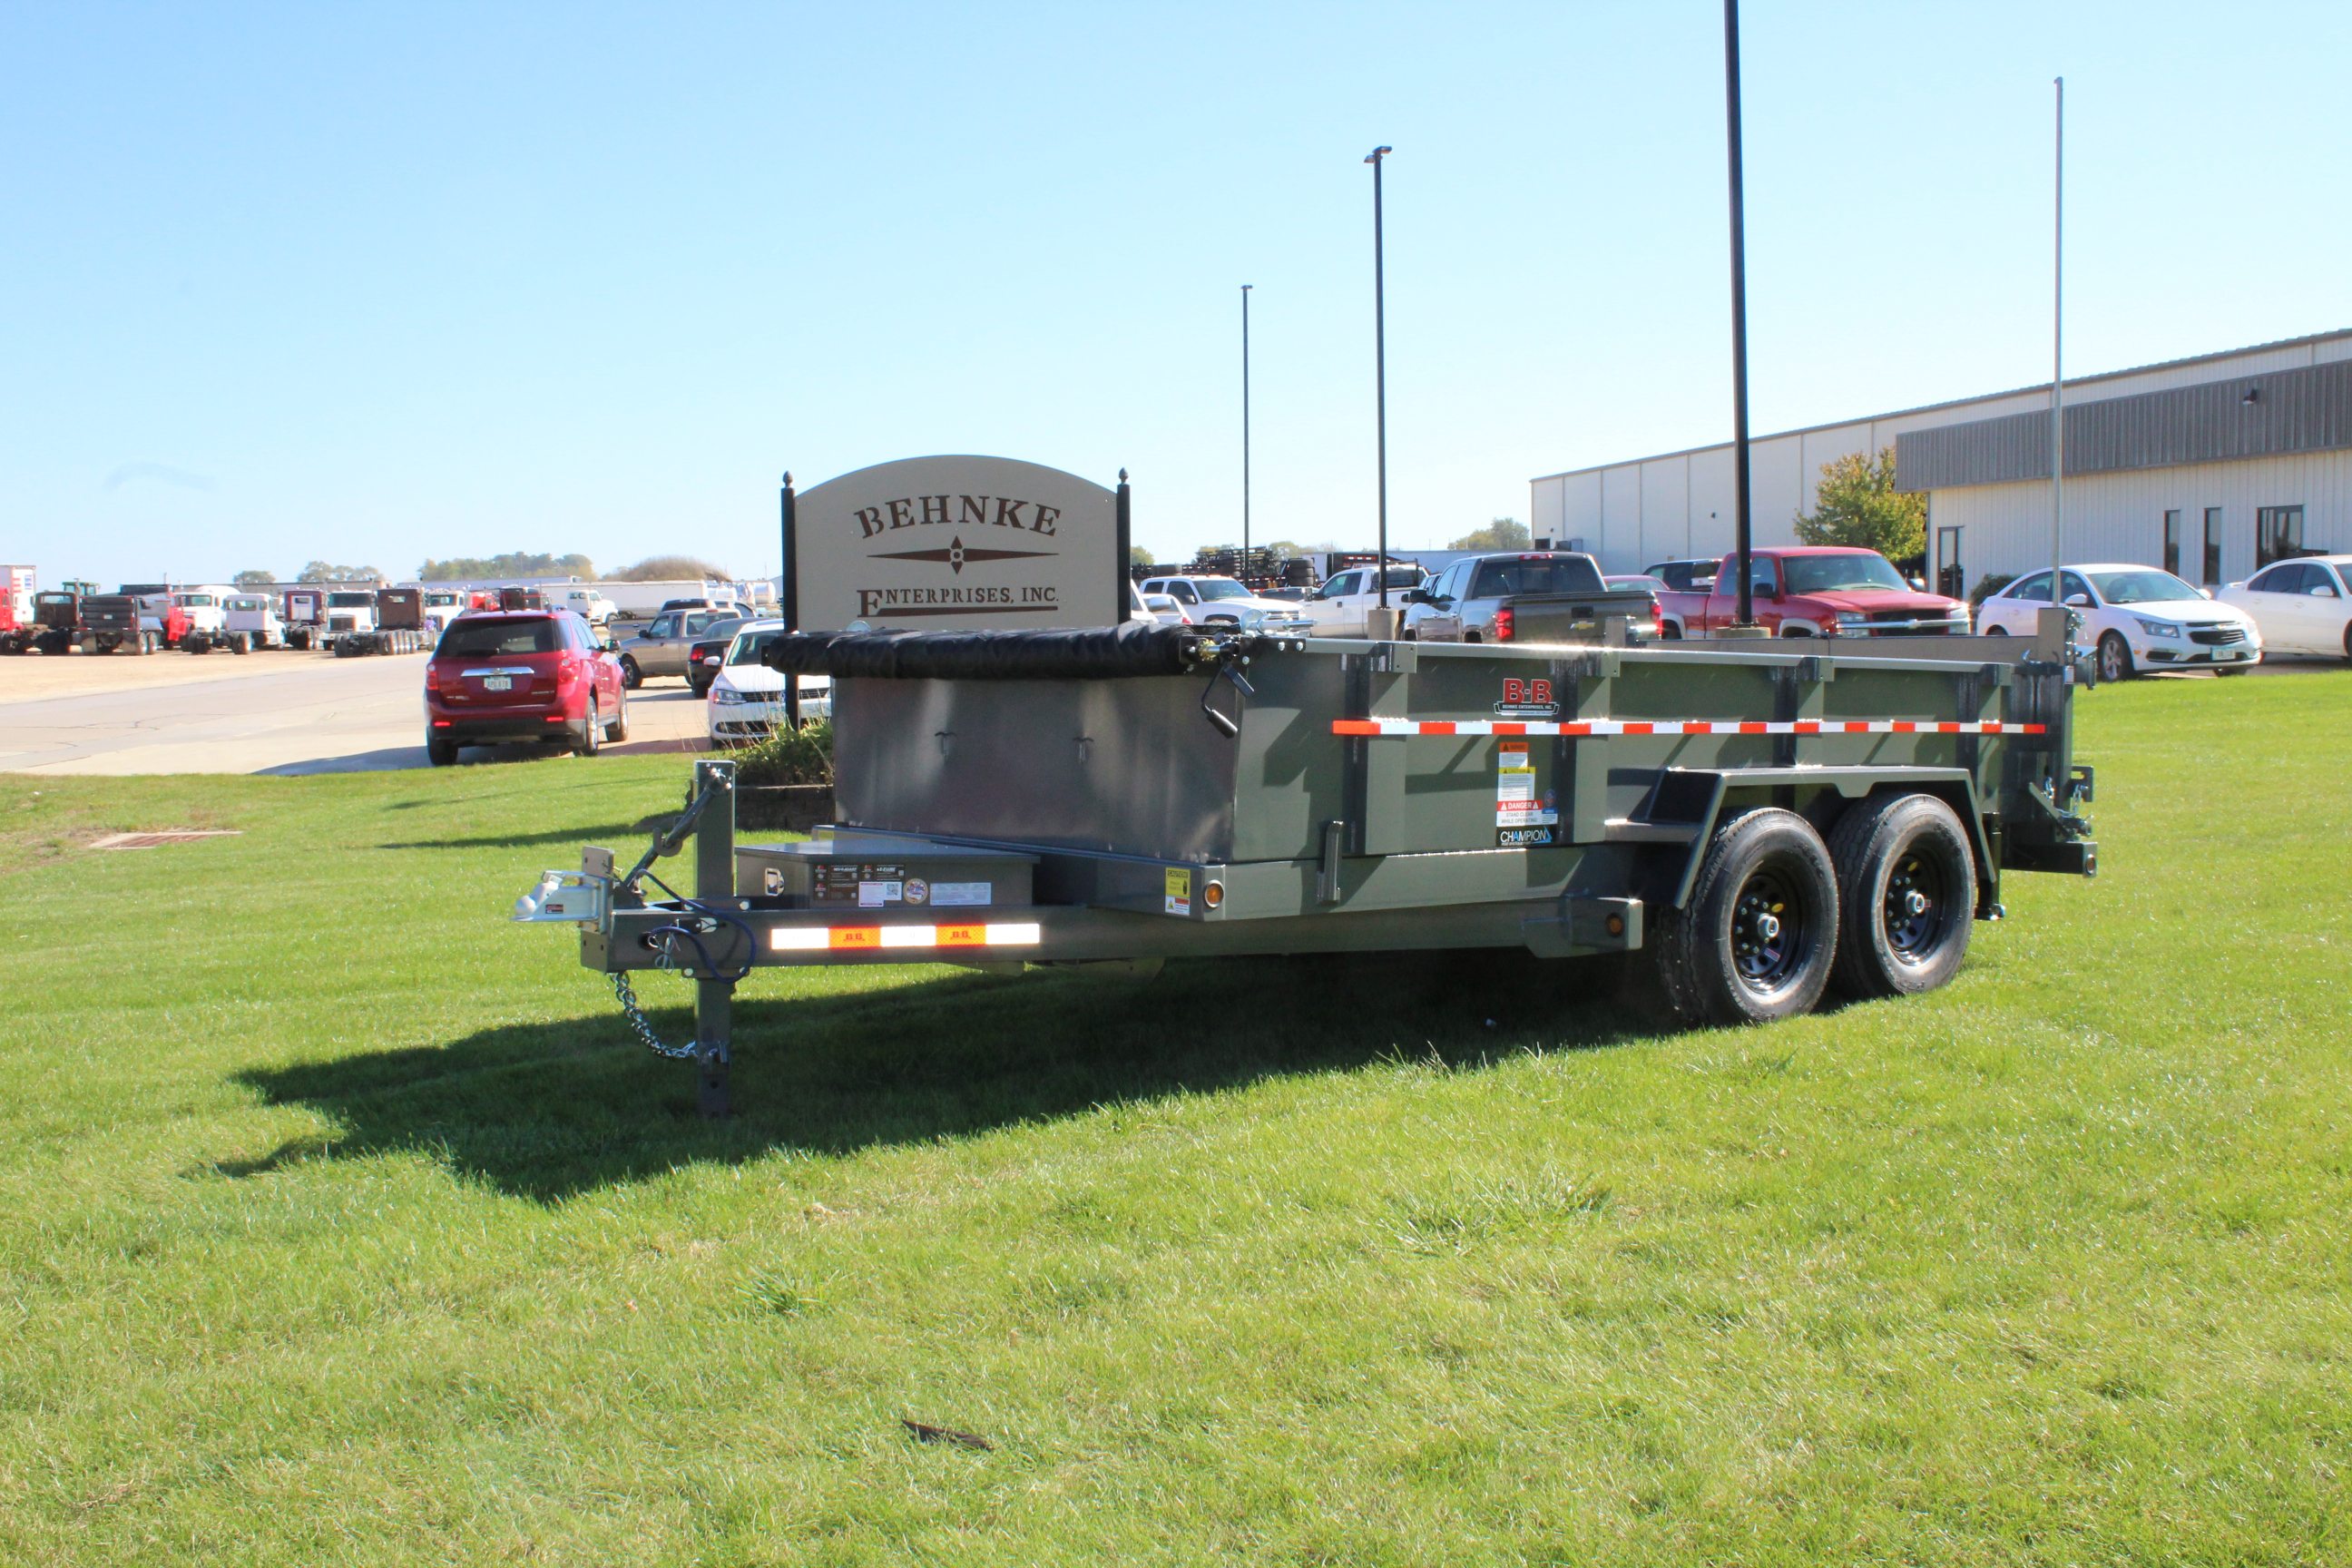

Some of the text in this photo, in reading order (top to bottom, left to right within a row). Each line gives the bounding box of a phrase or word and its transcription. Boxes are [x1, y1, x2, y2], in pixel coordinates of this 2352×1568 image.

[853, 494, 1062, 539] BEHNKE
[856, 586, 1059, 618] ENTERPRISES, INC.
[1500, 830, 1546, 842] CHAMPION
